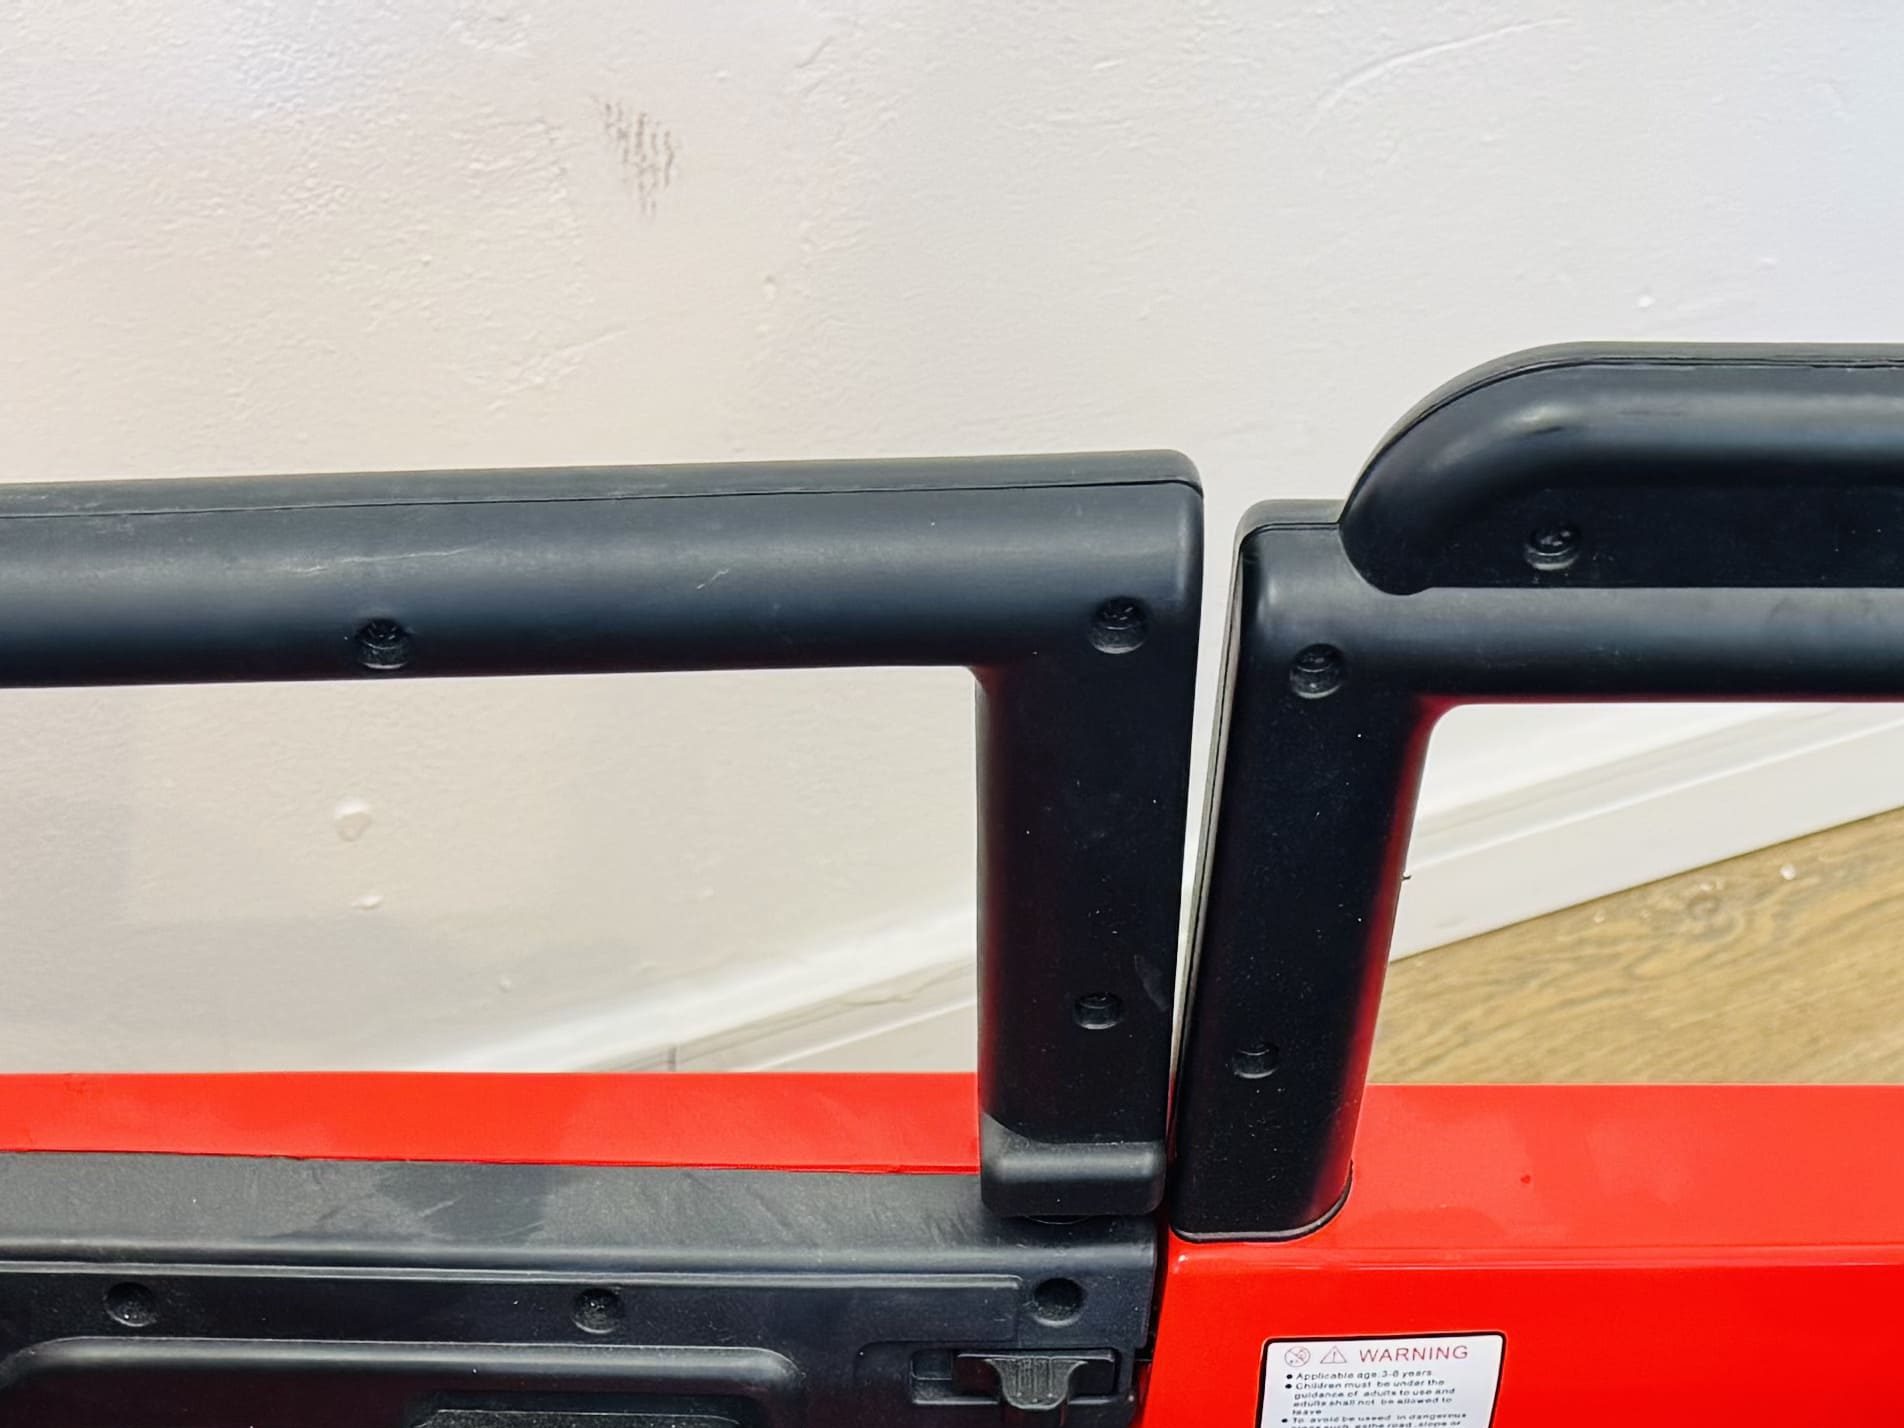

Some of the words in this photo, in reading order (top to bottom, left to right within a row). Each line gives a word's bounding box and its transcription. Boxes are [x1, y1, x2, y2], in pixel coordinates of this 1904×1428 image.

[1359, 1345, 1469, 1363] WARNING
[1295, 1371, 1355, 1381] Applicable
[1401, 1369, 1433, 1378] years
[1295, 1381, 1342, 1391] Children
[1344, 1380, 1372, 1389] must
[1376, 1380, 1391, 1388] be
[1393, 1379, 1425, 1387] under
[1427, 1378, 1446, 1386] the
[1294, 1391, 1345, 1400] guidance
[1347, 1390, 1359, 1398] of
[1399, 1389, 1410, 1397] to
[1434, 1387, 1456, 1395] and
[1357, 1398, 1376, 1407] not
[1442, 1396, 1453, 1404] to
